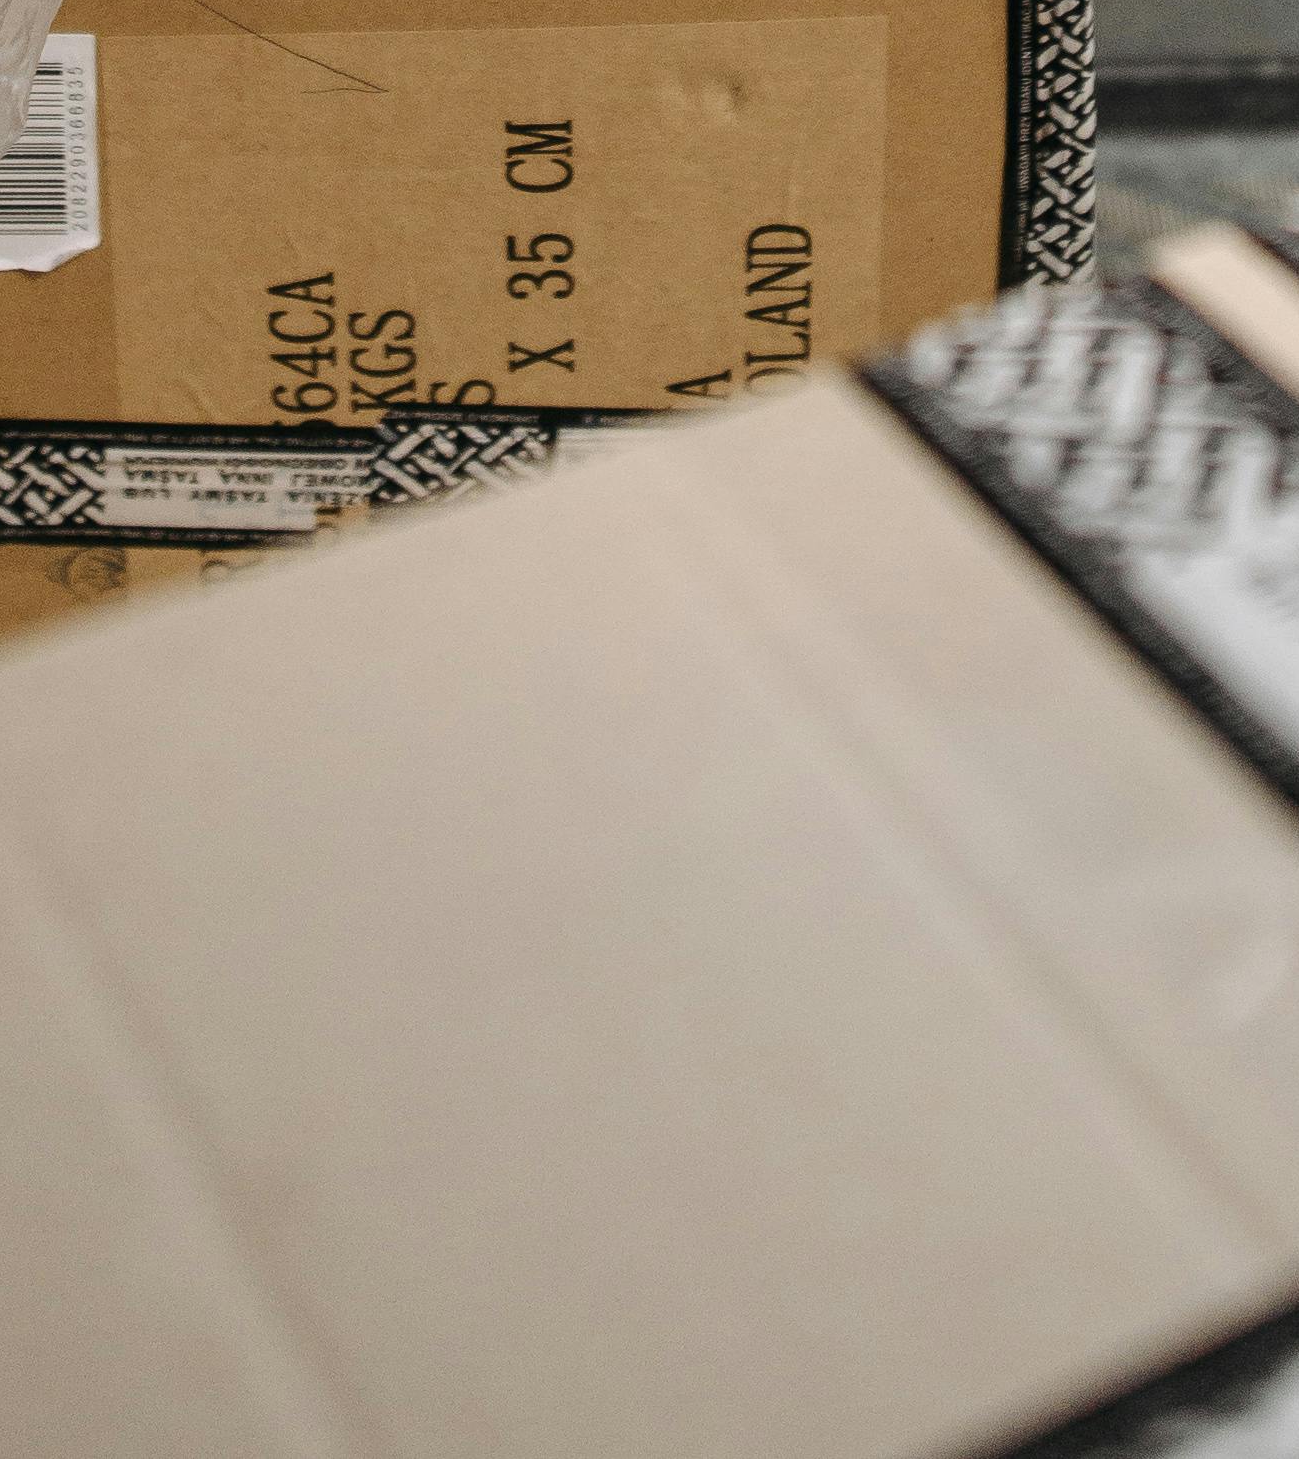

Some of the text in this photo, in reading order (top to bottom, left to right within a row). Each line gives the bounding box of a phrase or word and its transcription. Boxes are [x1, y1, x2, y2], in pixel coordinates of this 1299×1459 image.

[504, 120, 575, 373] X 35 CM
[267, 271, 339, 425] 64CA
[348, 309, 418, 412] KGS
